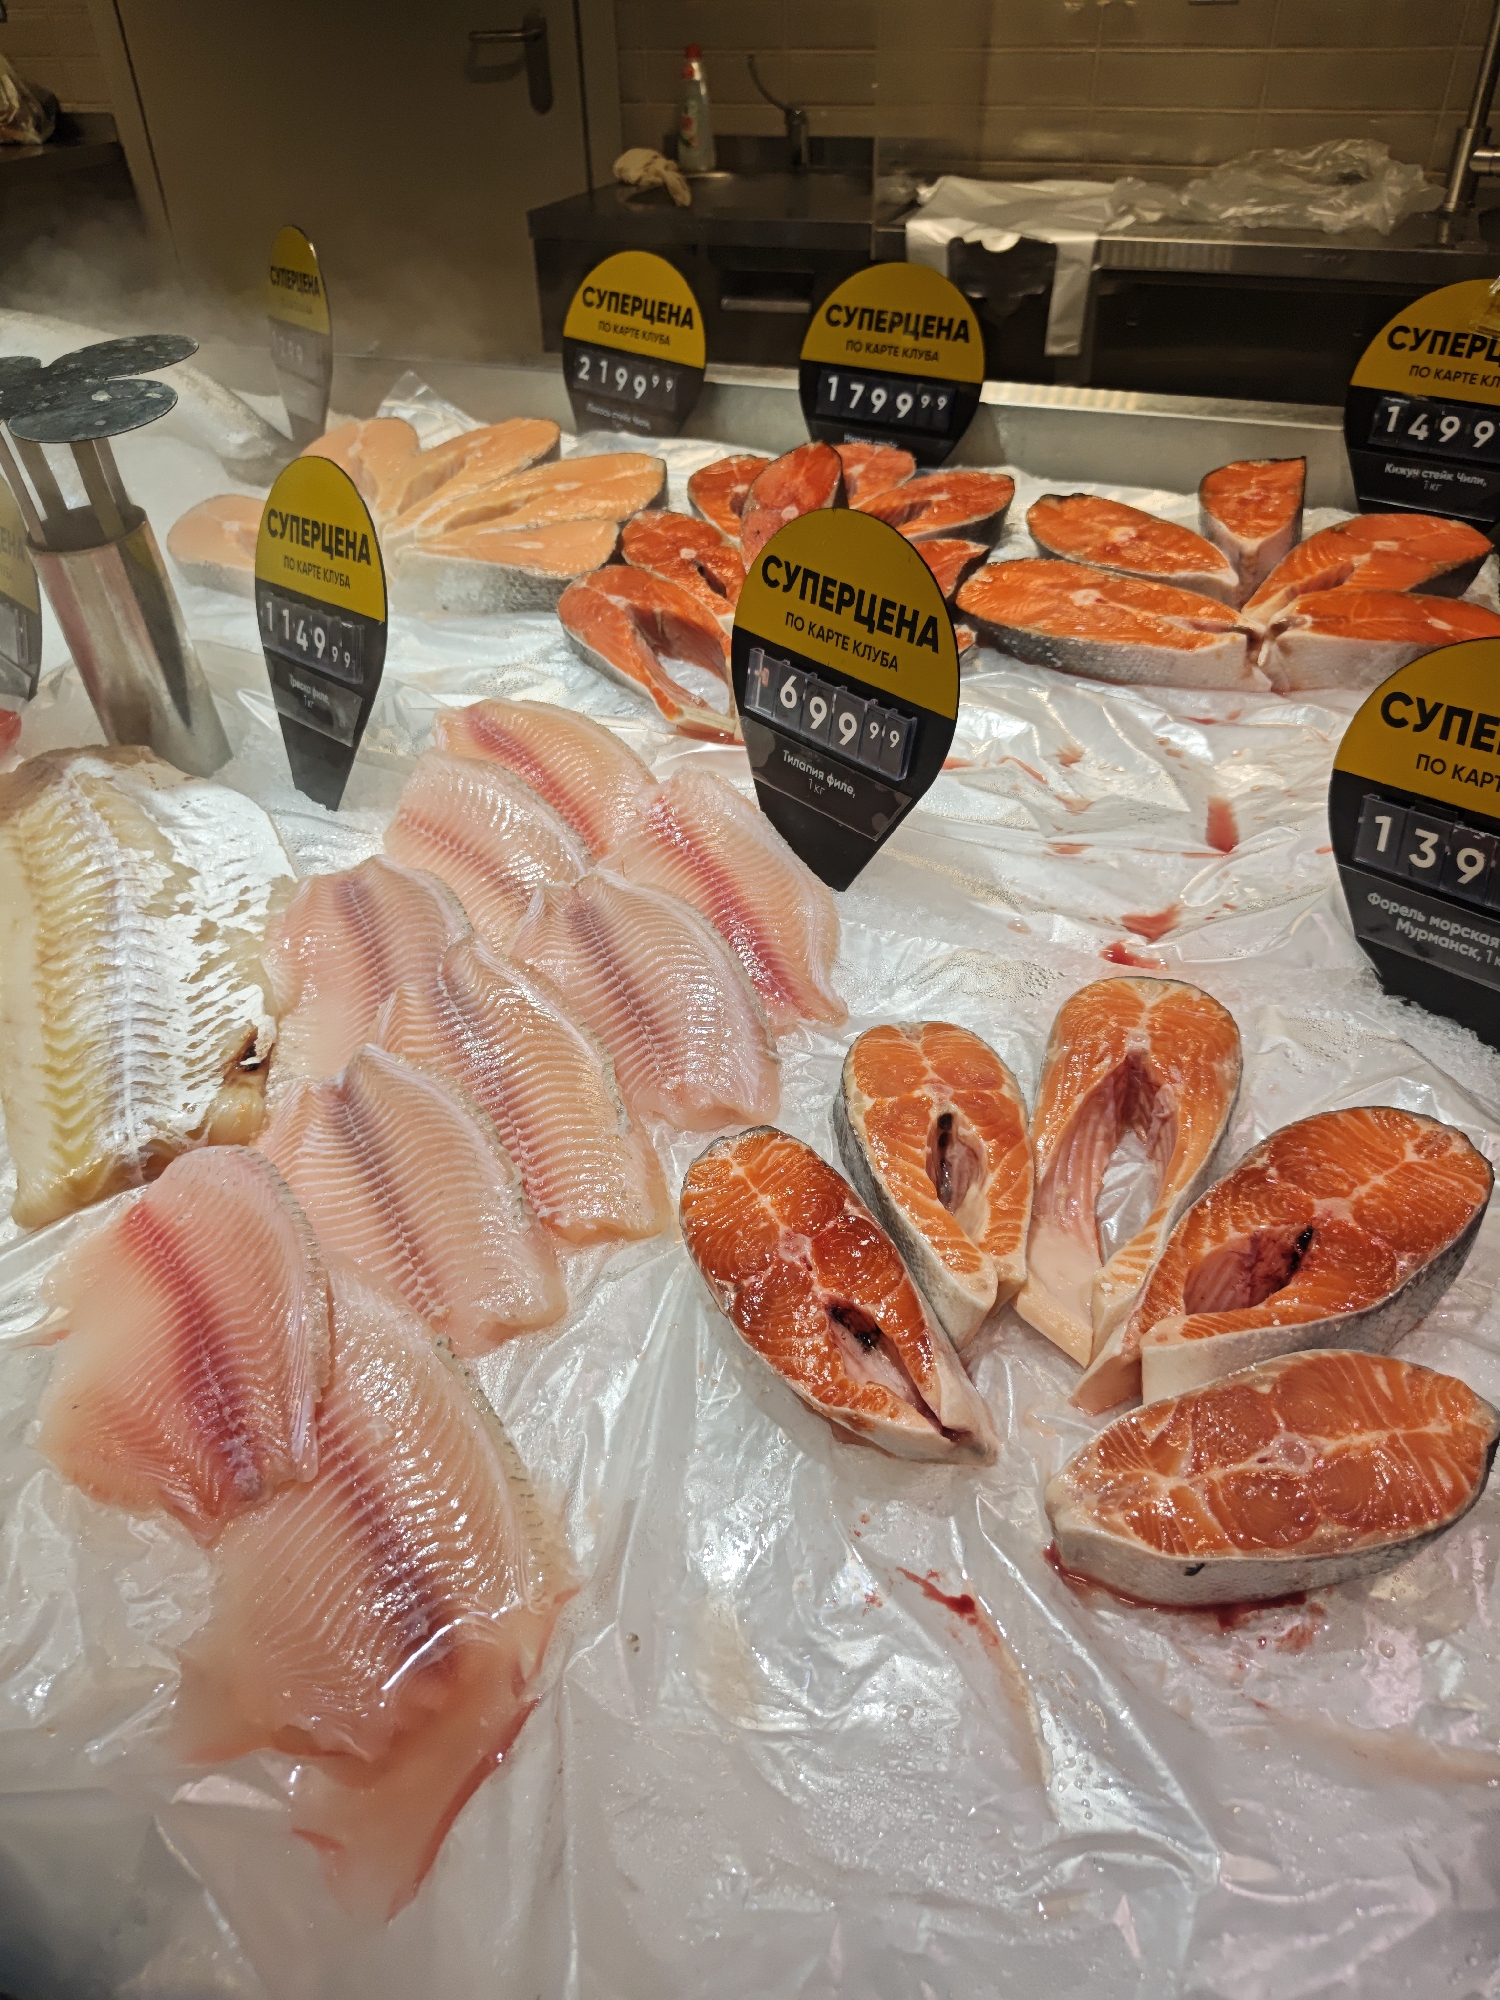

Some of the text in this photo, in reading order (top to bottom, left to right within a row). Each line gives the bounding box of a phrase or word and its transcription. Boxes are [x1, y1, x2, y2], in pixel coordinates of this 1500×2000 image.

[582, 285, 694, 330] СУПЕРЦЕНА
[825, 304, 970, 343] СУПЕРЦЕНА
[598, 320, 671, 346] ПО КАРТЕ КЛУБА
[846, 339, 939, 363] ПО КАРТЕ КЛУБА
[1409, 365, 1430, 379] ПО
[1433, 368, 1479, 385] КАРТЕ
[1385, 405, 1495, 448] 1499
[1384, 462, 1420, 479] Кижуч
[1421, 470, 1454, 481] стейк
[267, 508, 372, 566] СУПЕРЦЕНА
[283, 555, 351, 590] ПО КАРТЕ КЛУБА
[761, 555, 939, 654] СУПЕРЦЕНА
[785, 611, 898, 672] ПО КАРТЕ КЛУБА
[1381, 691, 1500, 755] СУПЕ
[783, 750, 824, 780] Тилапия
[1416, 753, 1446, 775] ПО
[814, 784, 826, 795] кг
[1374, 815, 1485, 885] 139
[1367, 892, 1500, 948] Форель морская
[1395, 918, 1482, 962] Мурманск,
[1486, 949, 1493, 963] 1
